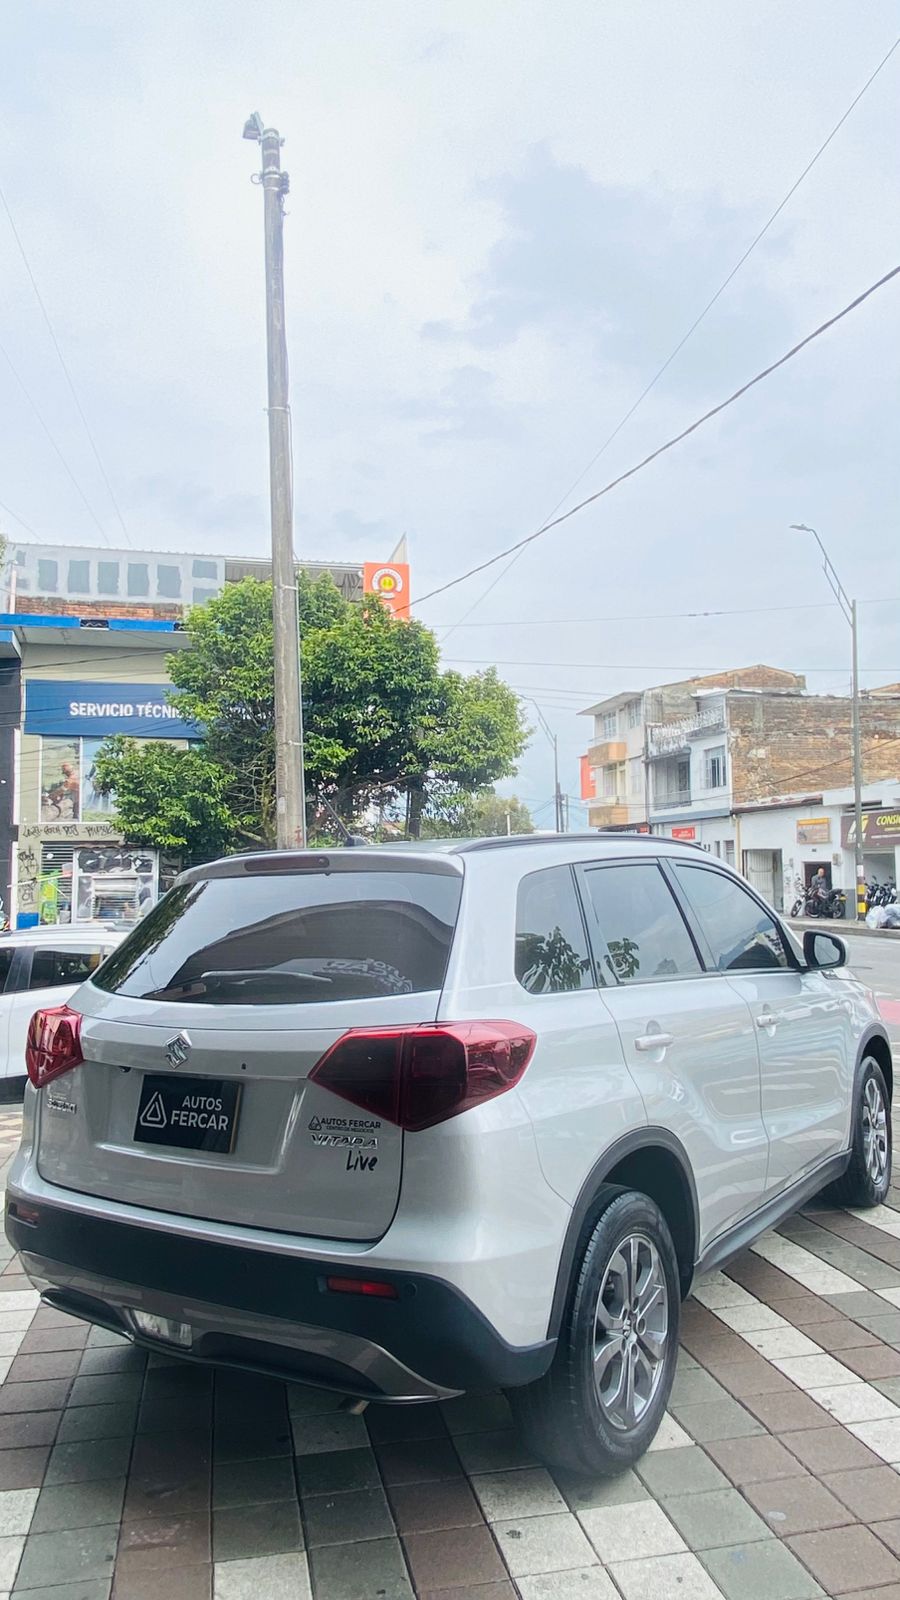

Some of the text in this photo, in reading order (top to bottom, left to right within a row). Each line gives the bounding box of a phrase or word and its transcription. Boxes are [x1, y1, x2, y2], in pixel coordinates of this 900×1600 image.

[69, 702, 133, 717] SERVICIO
[182, 1095, 222, 1111] AUTOS
[170, 1110, 229, 1131] FERCAR
[349, 1120, 381, 1128] FERCAR
[310, 1133, 378, 1149] VITARA
[346, 1150, 378, 1171] Live
